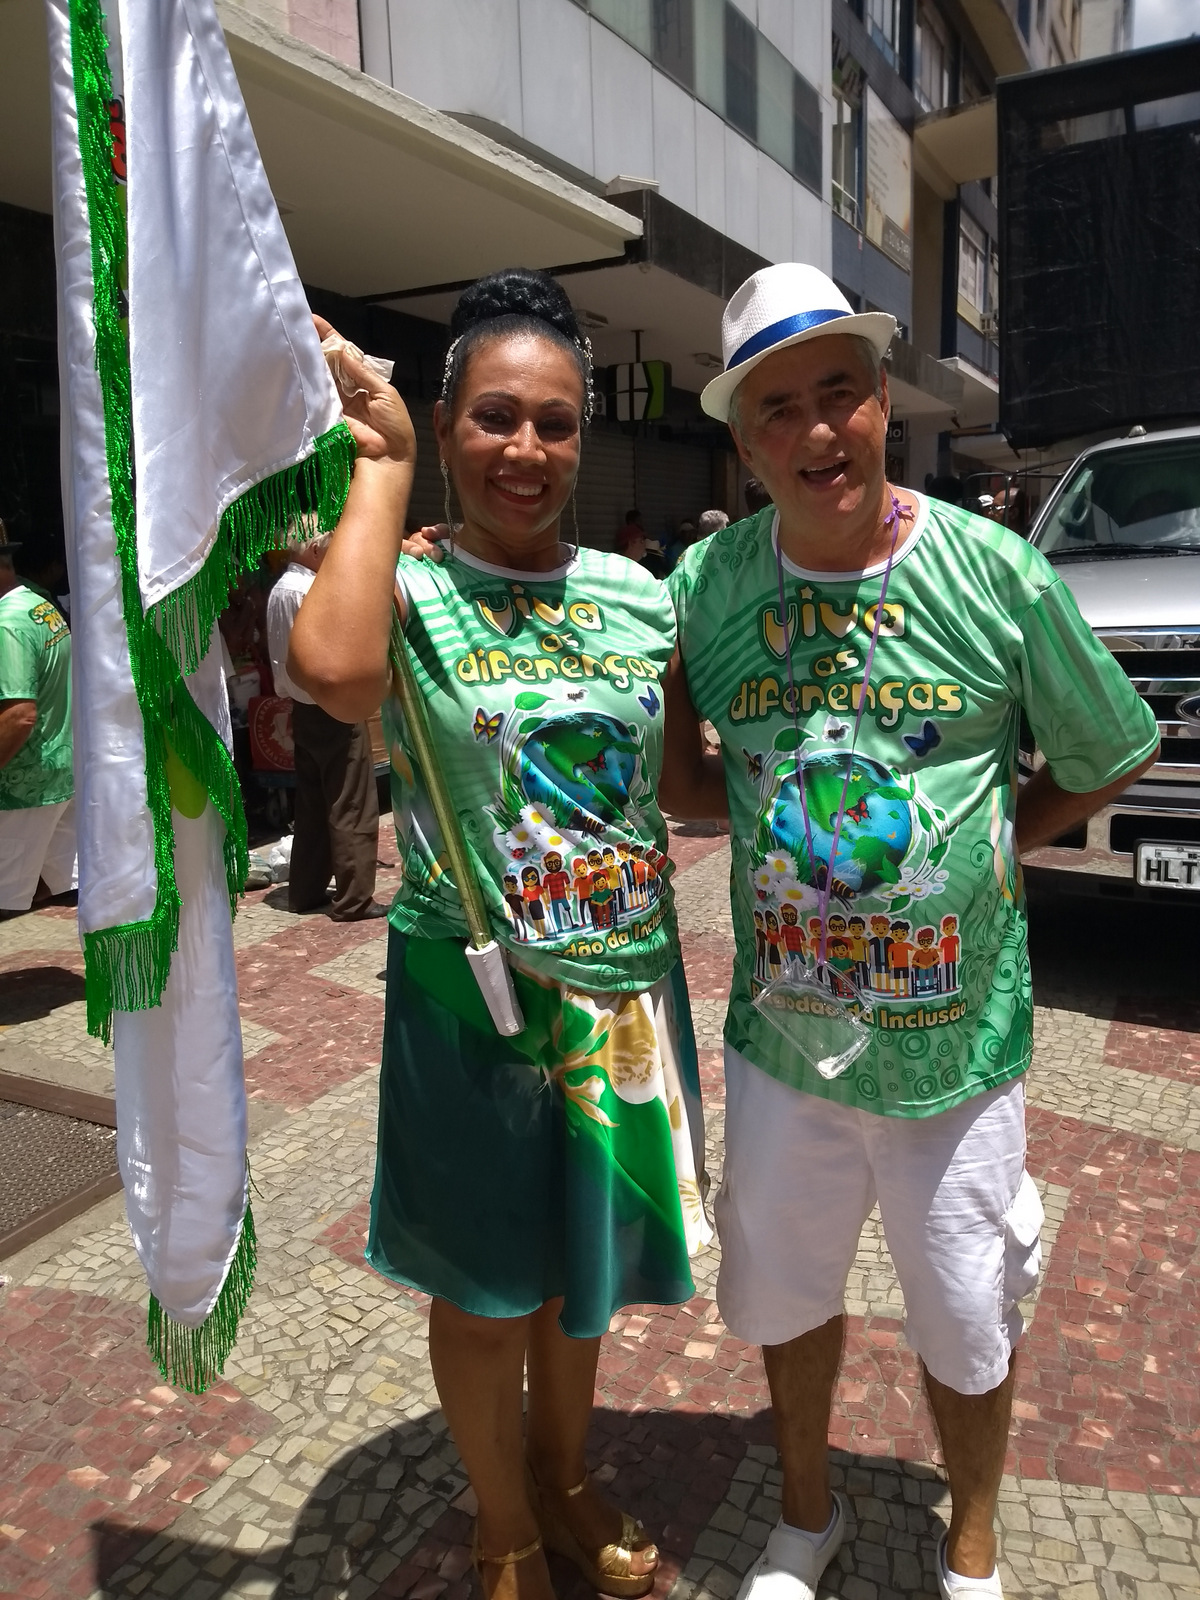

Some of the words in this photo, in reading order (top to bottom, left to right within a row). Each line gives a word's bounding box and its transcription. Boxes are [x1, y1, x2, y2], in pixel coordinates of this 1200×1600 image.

[541, 633, 580, 653] as
[456, 648, 660, 689] diferenças
[814, 649, 860, 677] as
[730, 677, 962, 727] diferenças
[551, 941, 605, 957] dão
[606, 929, 630, 950] da
[847, 1003, 875, 1025] da
[880, 1001, 967, 1030] Inclusão
